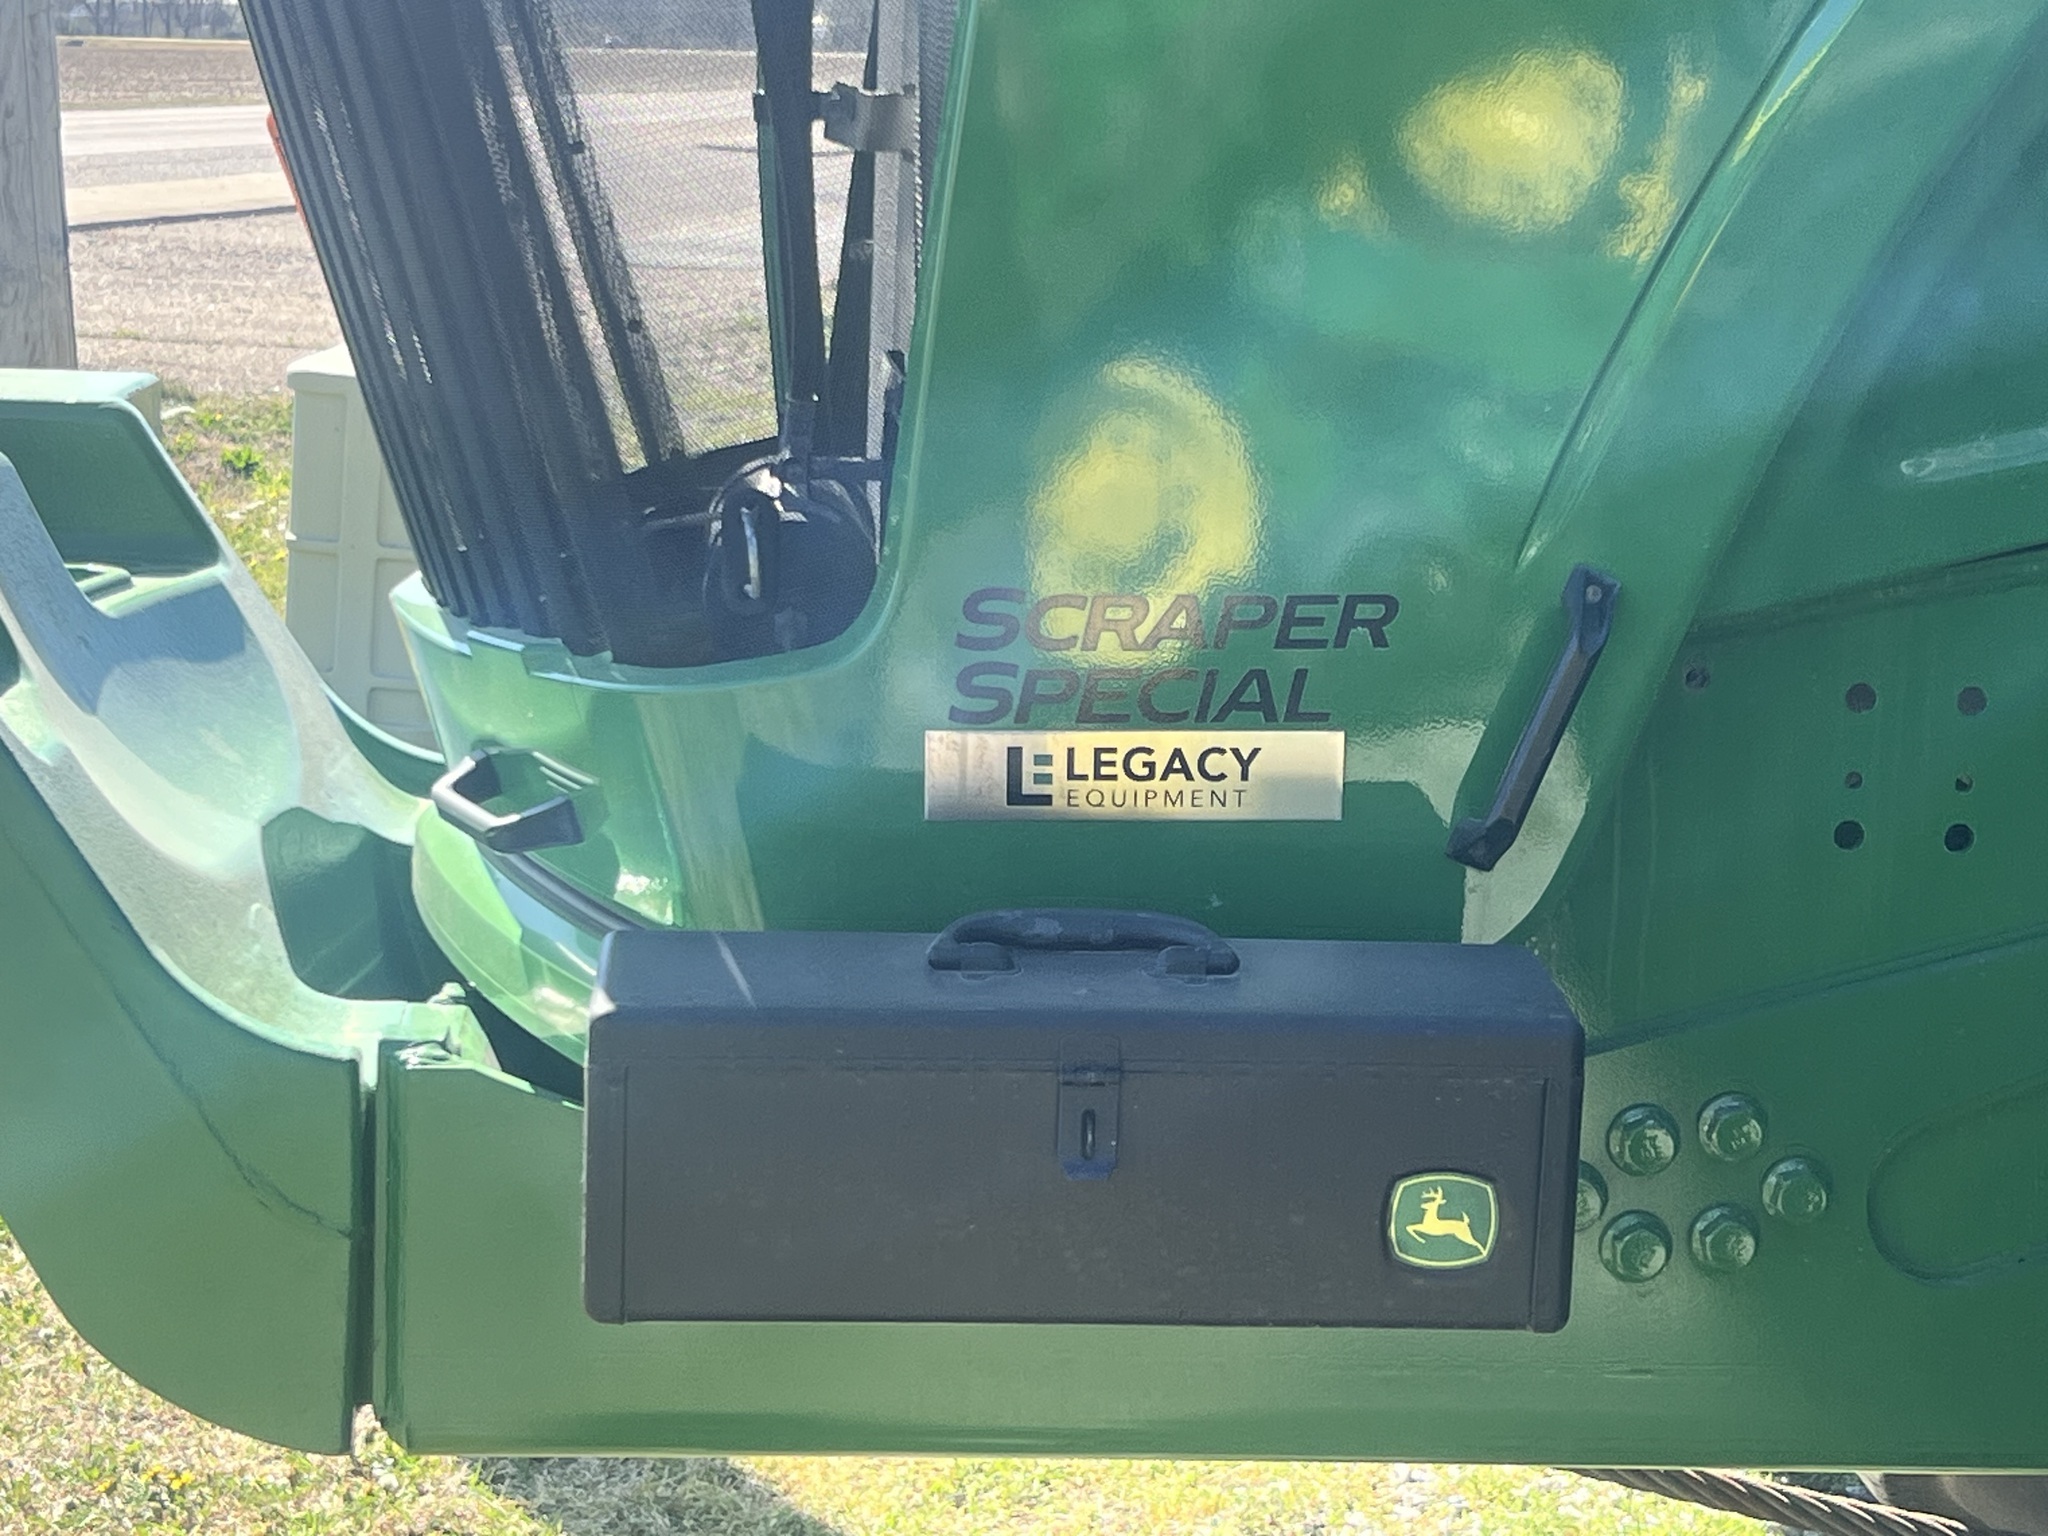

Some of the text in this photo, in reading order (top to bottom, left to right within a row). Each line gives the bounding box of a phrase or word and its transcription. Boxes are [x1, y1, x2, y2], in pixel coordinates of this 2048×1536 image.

[954, 587, 1400, 651] SCRAPER
[948, 661, 1331, 724] SPECIAL
[1067, 747, 1262, 782] LEGACY
[1067, 788, 1247, 808] EQUIPMENT
